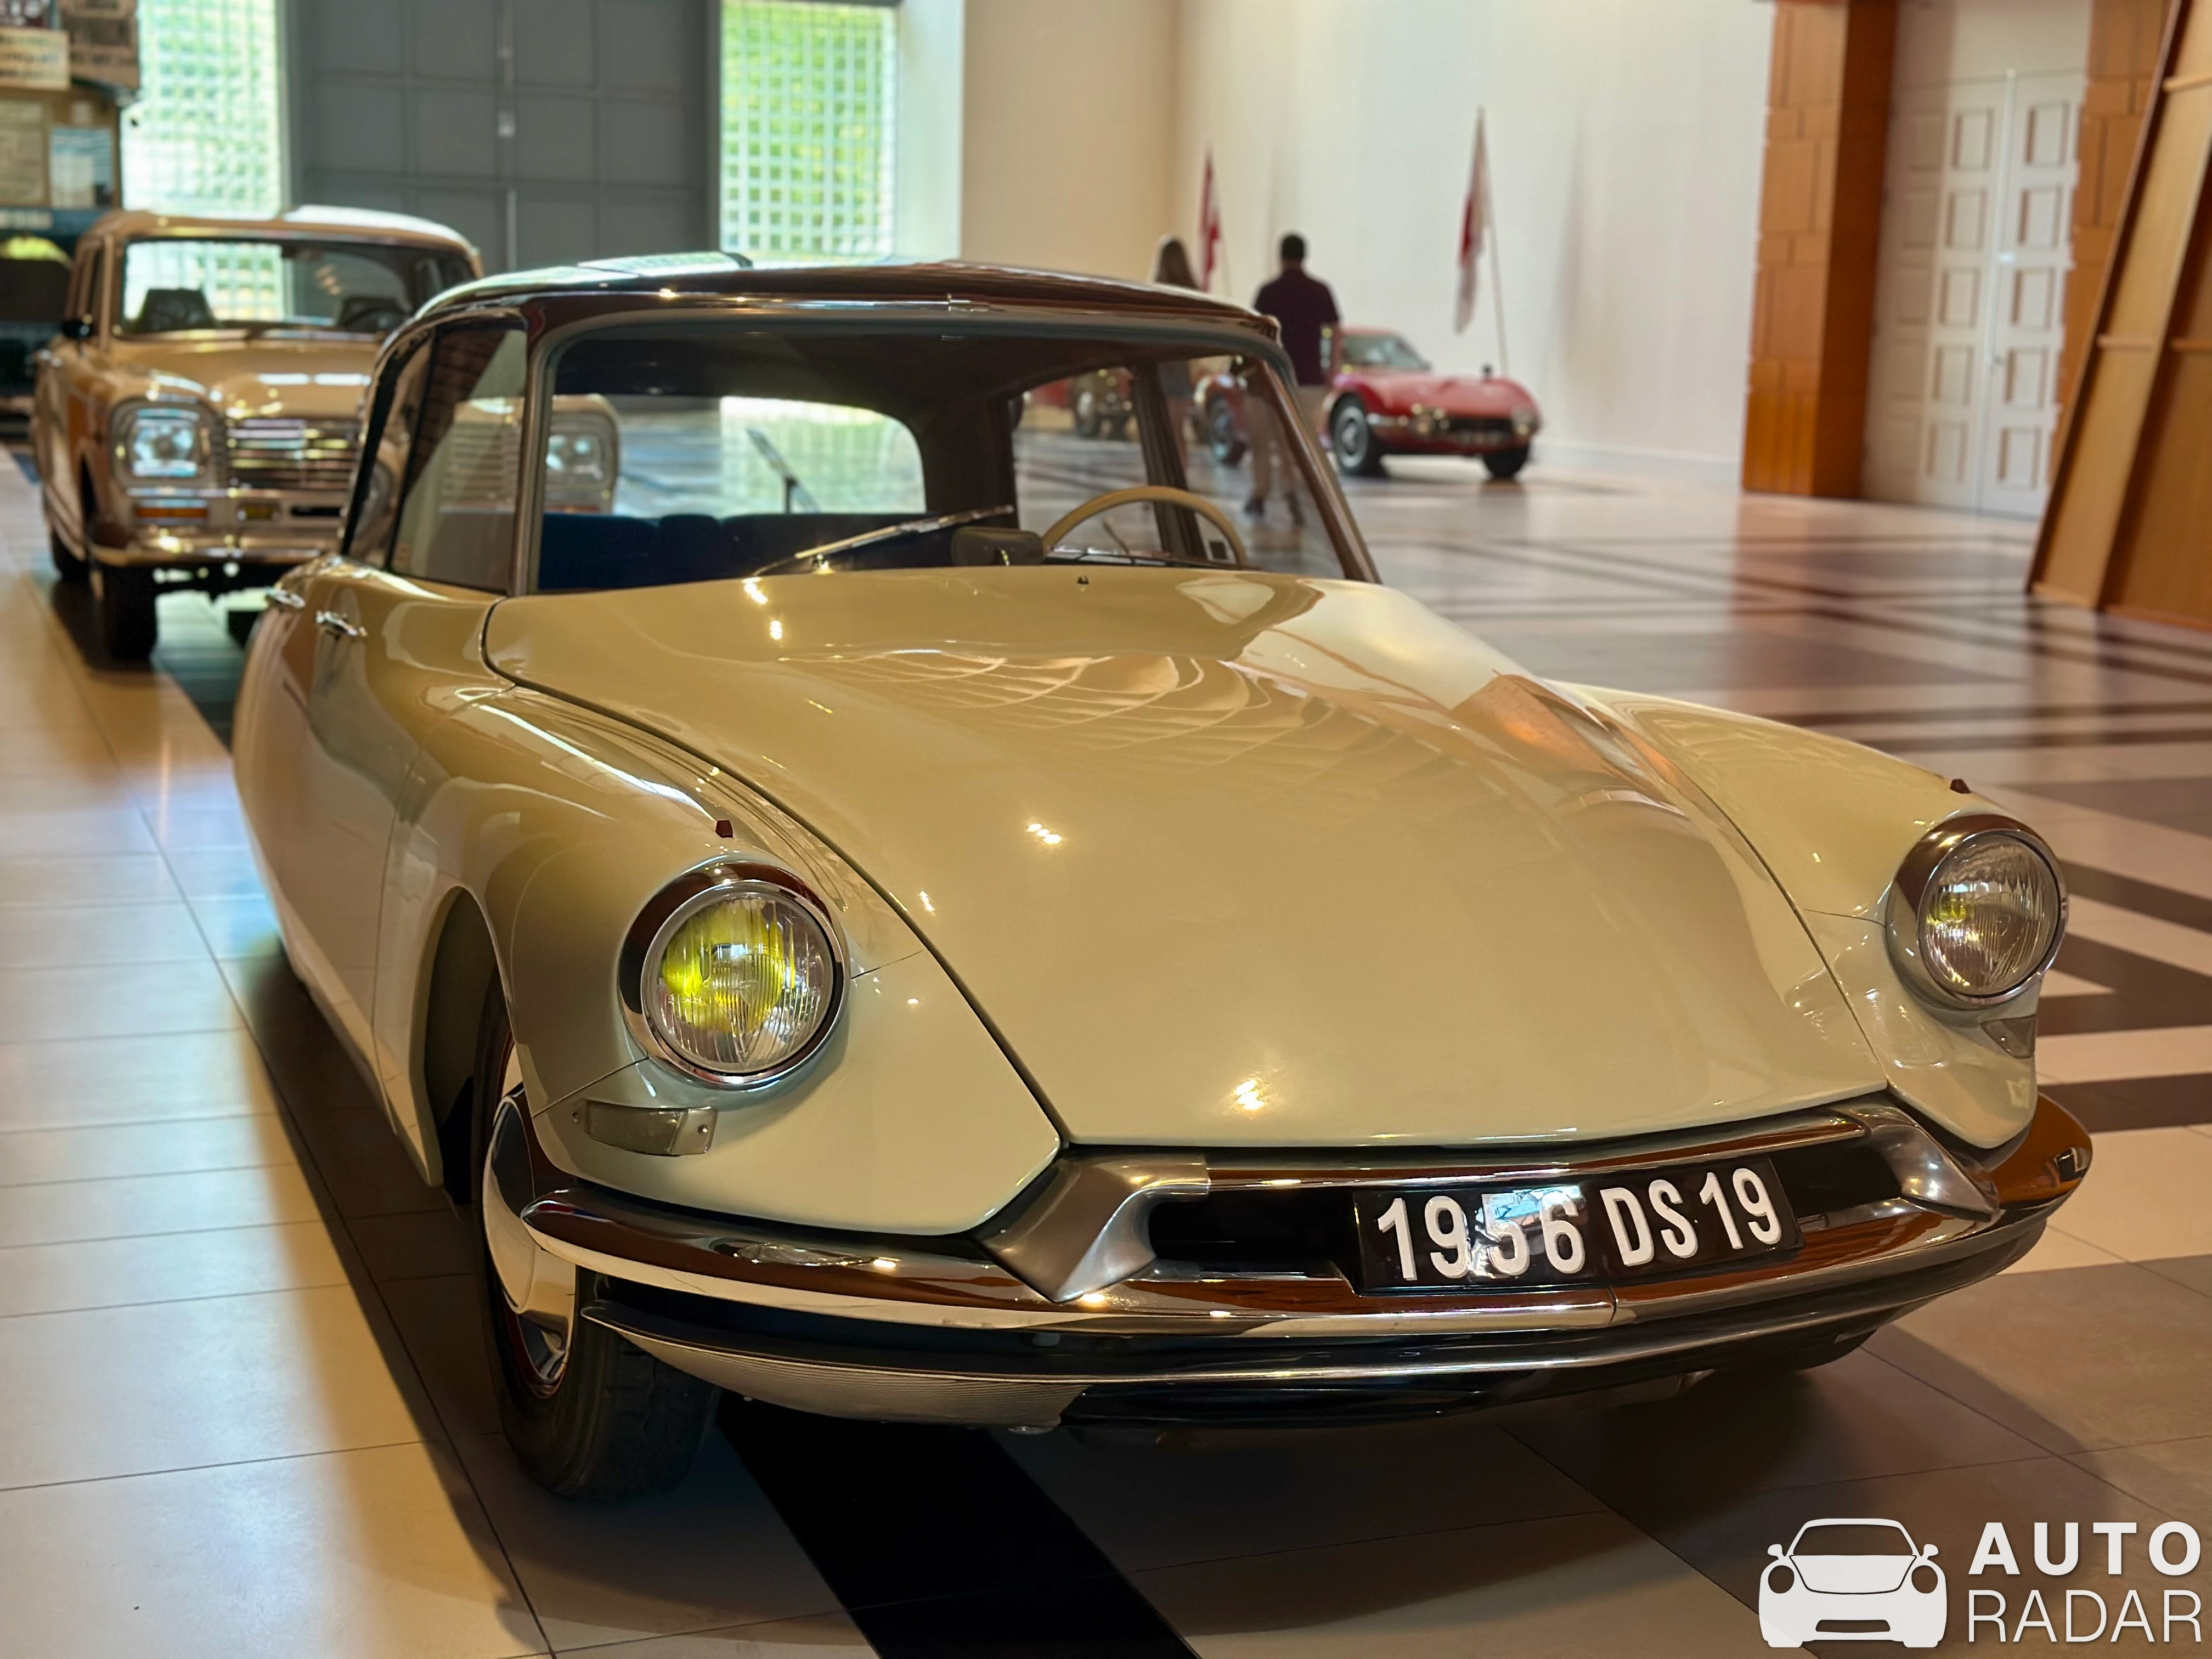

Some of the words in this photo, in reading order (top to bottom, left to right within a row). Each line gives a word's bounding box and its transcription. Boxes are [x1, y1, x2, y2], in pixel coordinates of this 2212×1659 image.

[1376, 1191, 1587, 1282] 1956
[1599, 1179, 1699, 1267] DS
[1699, 1167, 1783, 1250] 19
